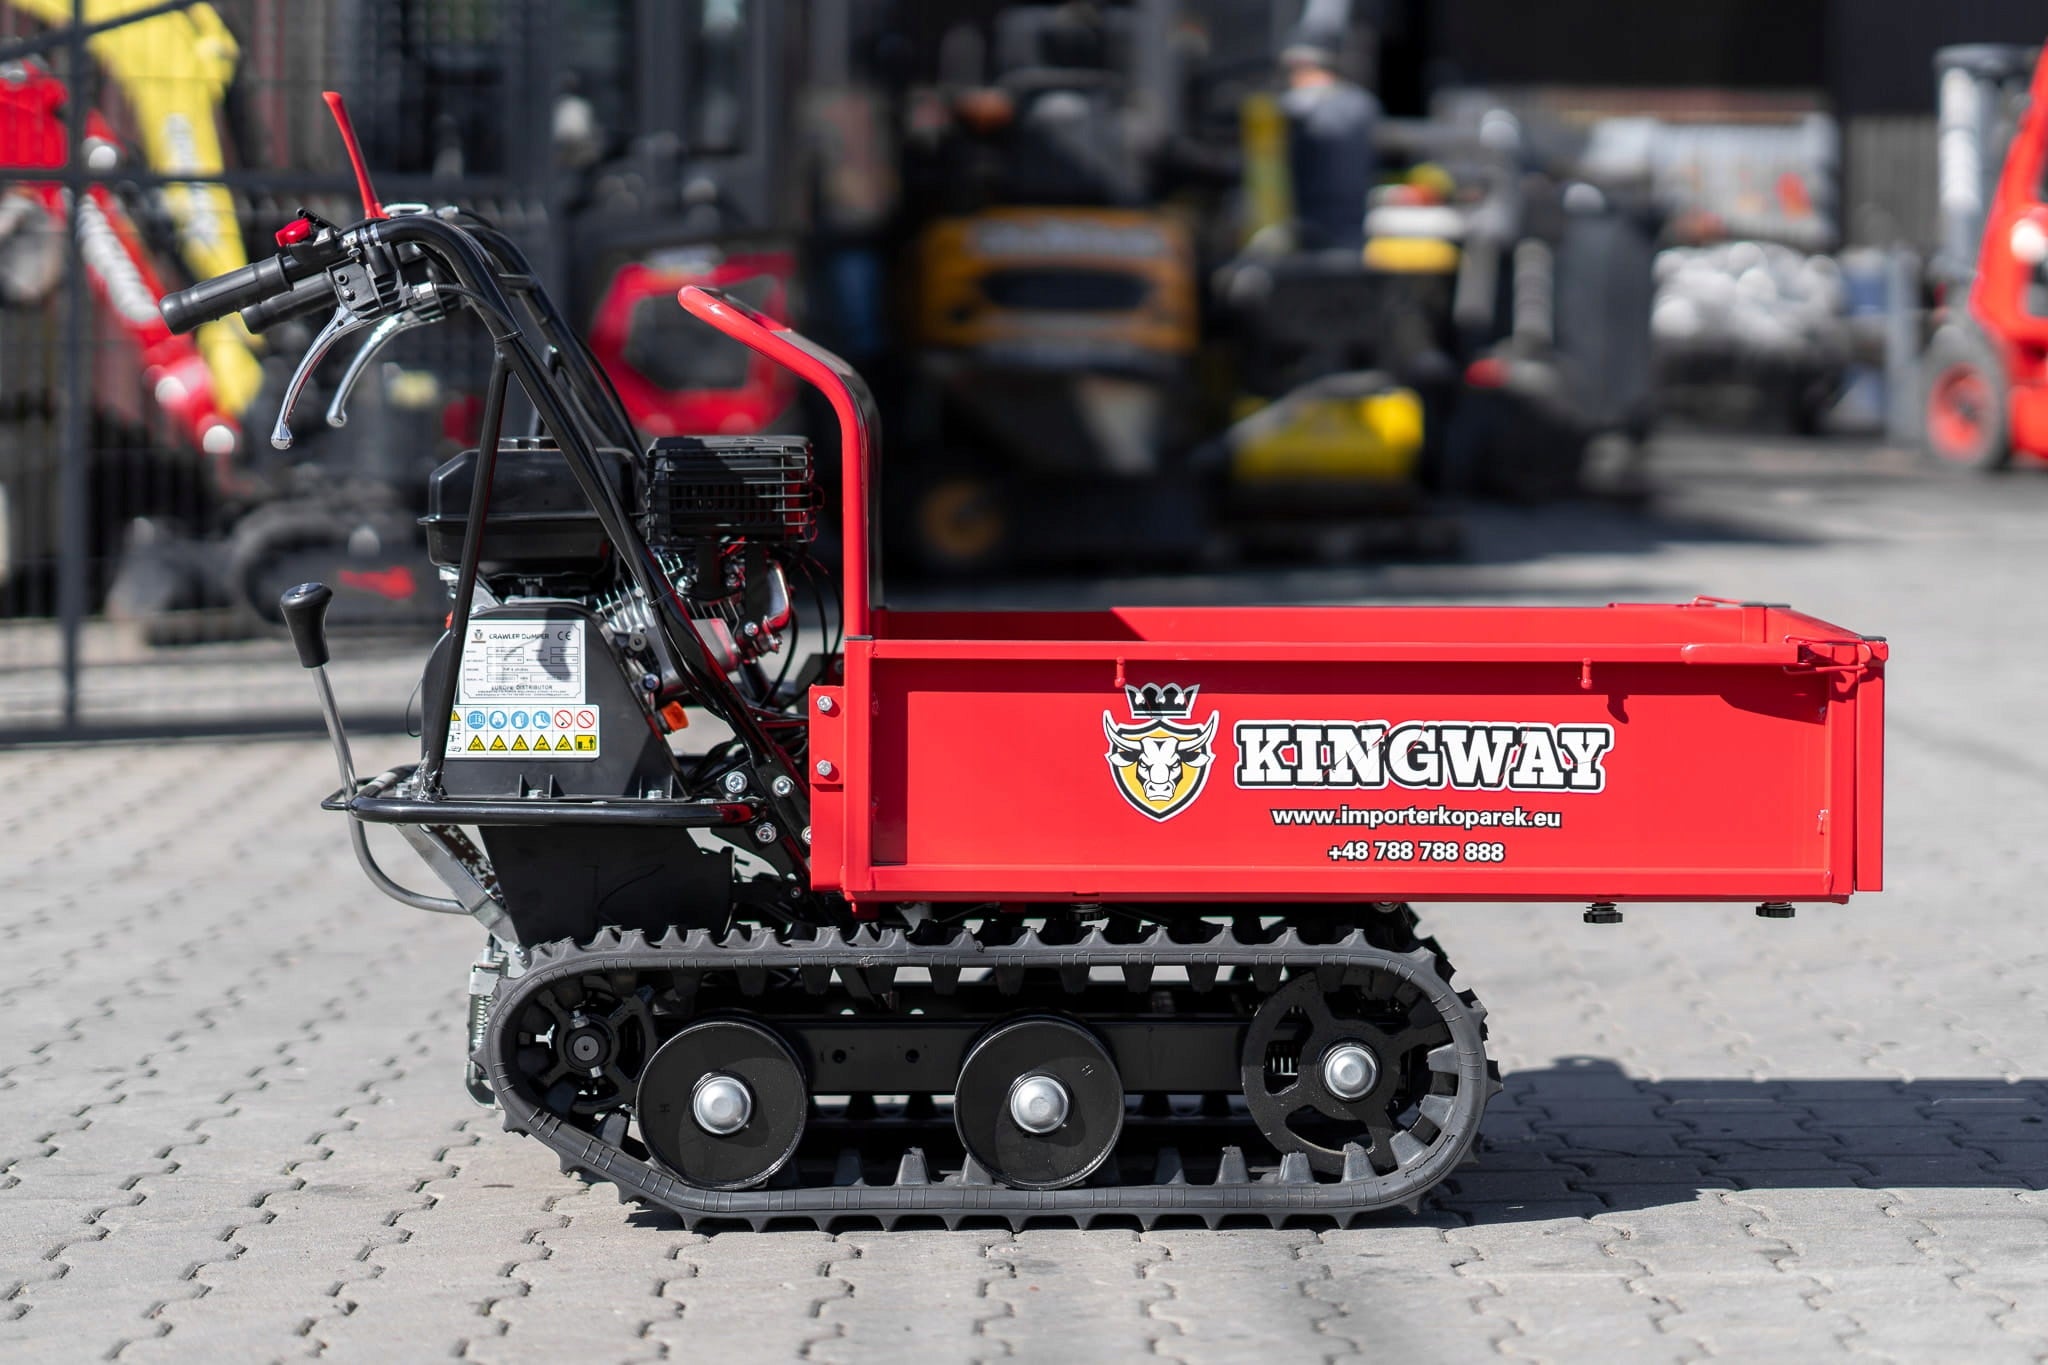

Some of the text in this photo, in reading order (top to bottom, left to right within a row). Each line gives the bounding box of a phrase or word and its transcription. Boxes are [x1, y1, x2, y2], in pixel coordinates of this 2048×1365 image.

[1235, 721, 1613, 791] KINGWAY
[1271, 805, 1562, 829] www.importerkoparek.eu
[1328, 840, 1505, 862] +48 788 788 888
